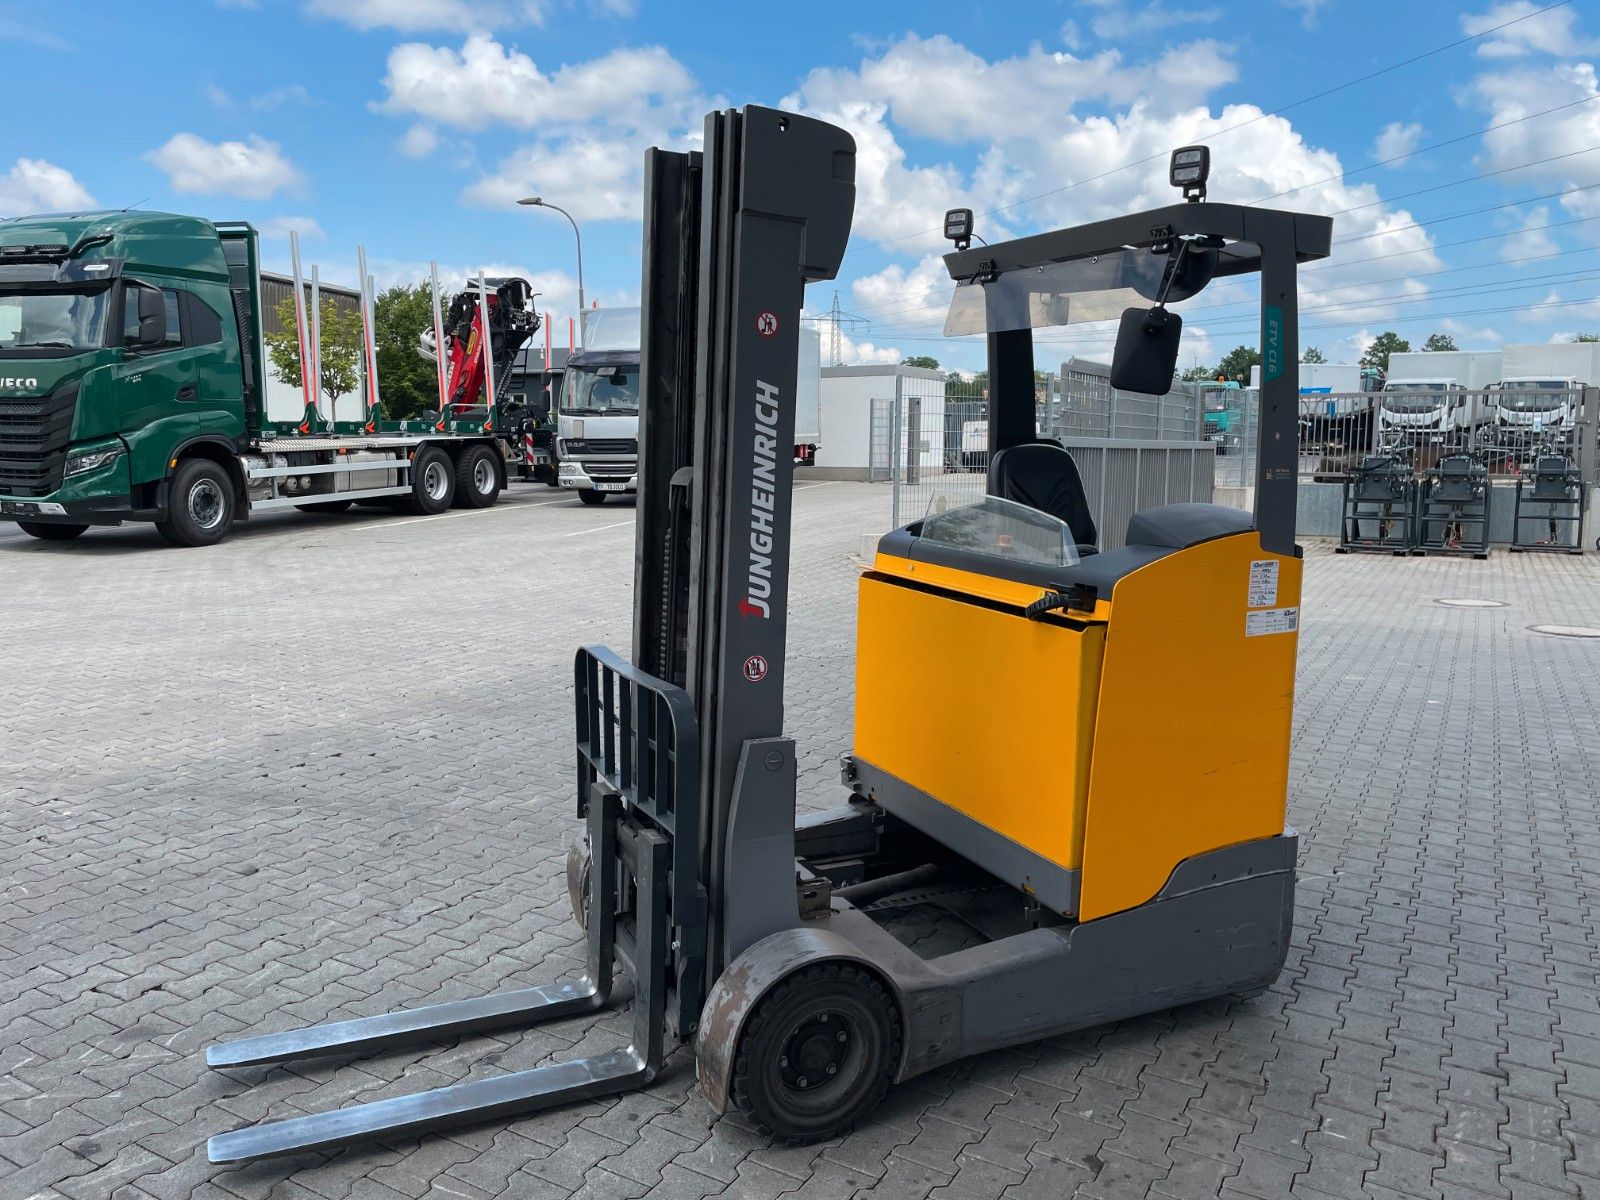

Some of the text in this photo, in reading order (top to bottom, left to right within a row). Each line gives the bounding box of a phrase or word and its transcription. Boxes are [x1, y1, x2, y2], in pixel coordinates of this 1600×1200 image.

[1269, 320, 1278, 347] ETV
[0, 377, 38, 389] ECO
[746, 379, 779, 619] JUNGHEINRICH
